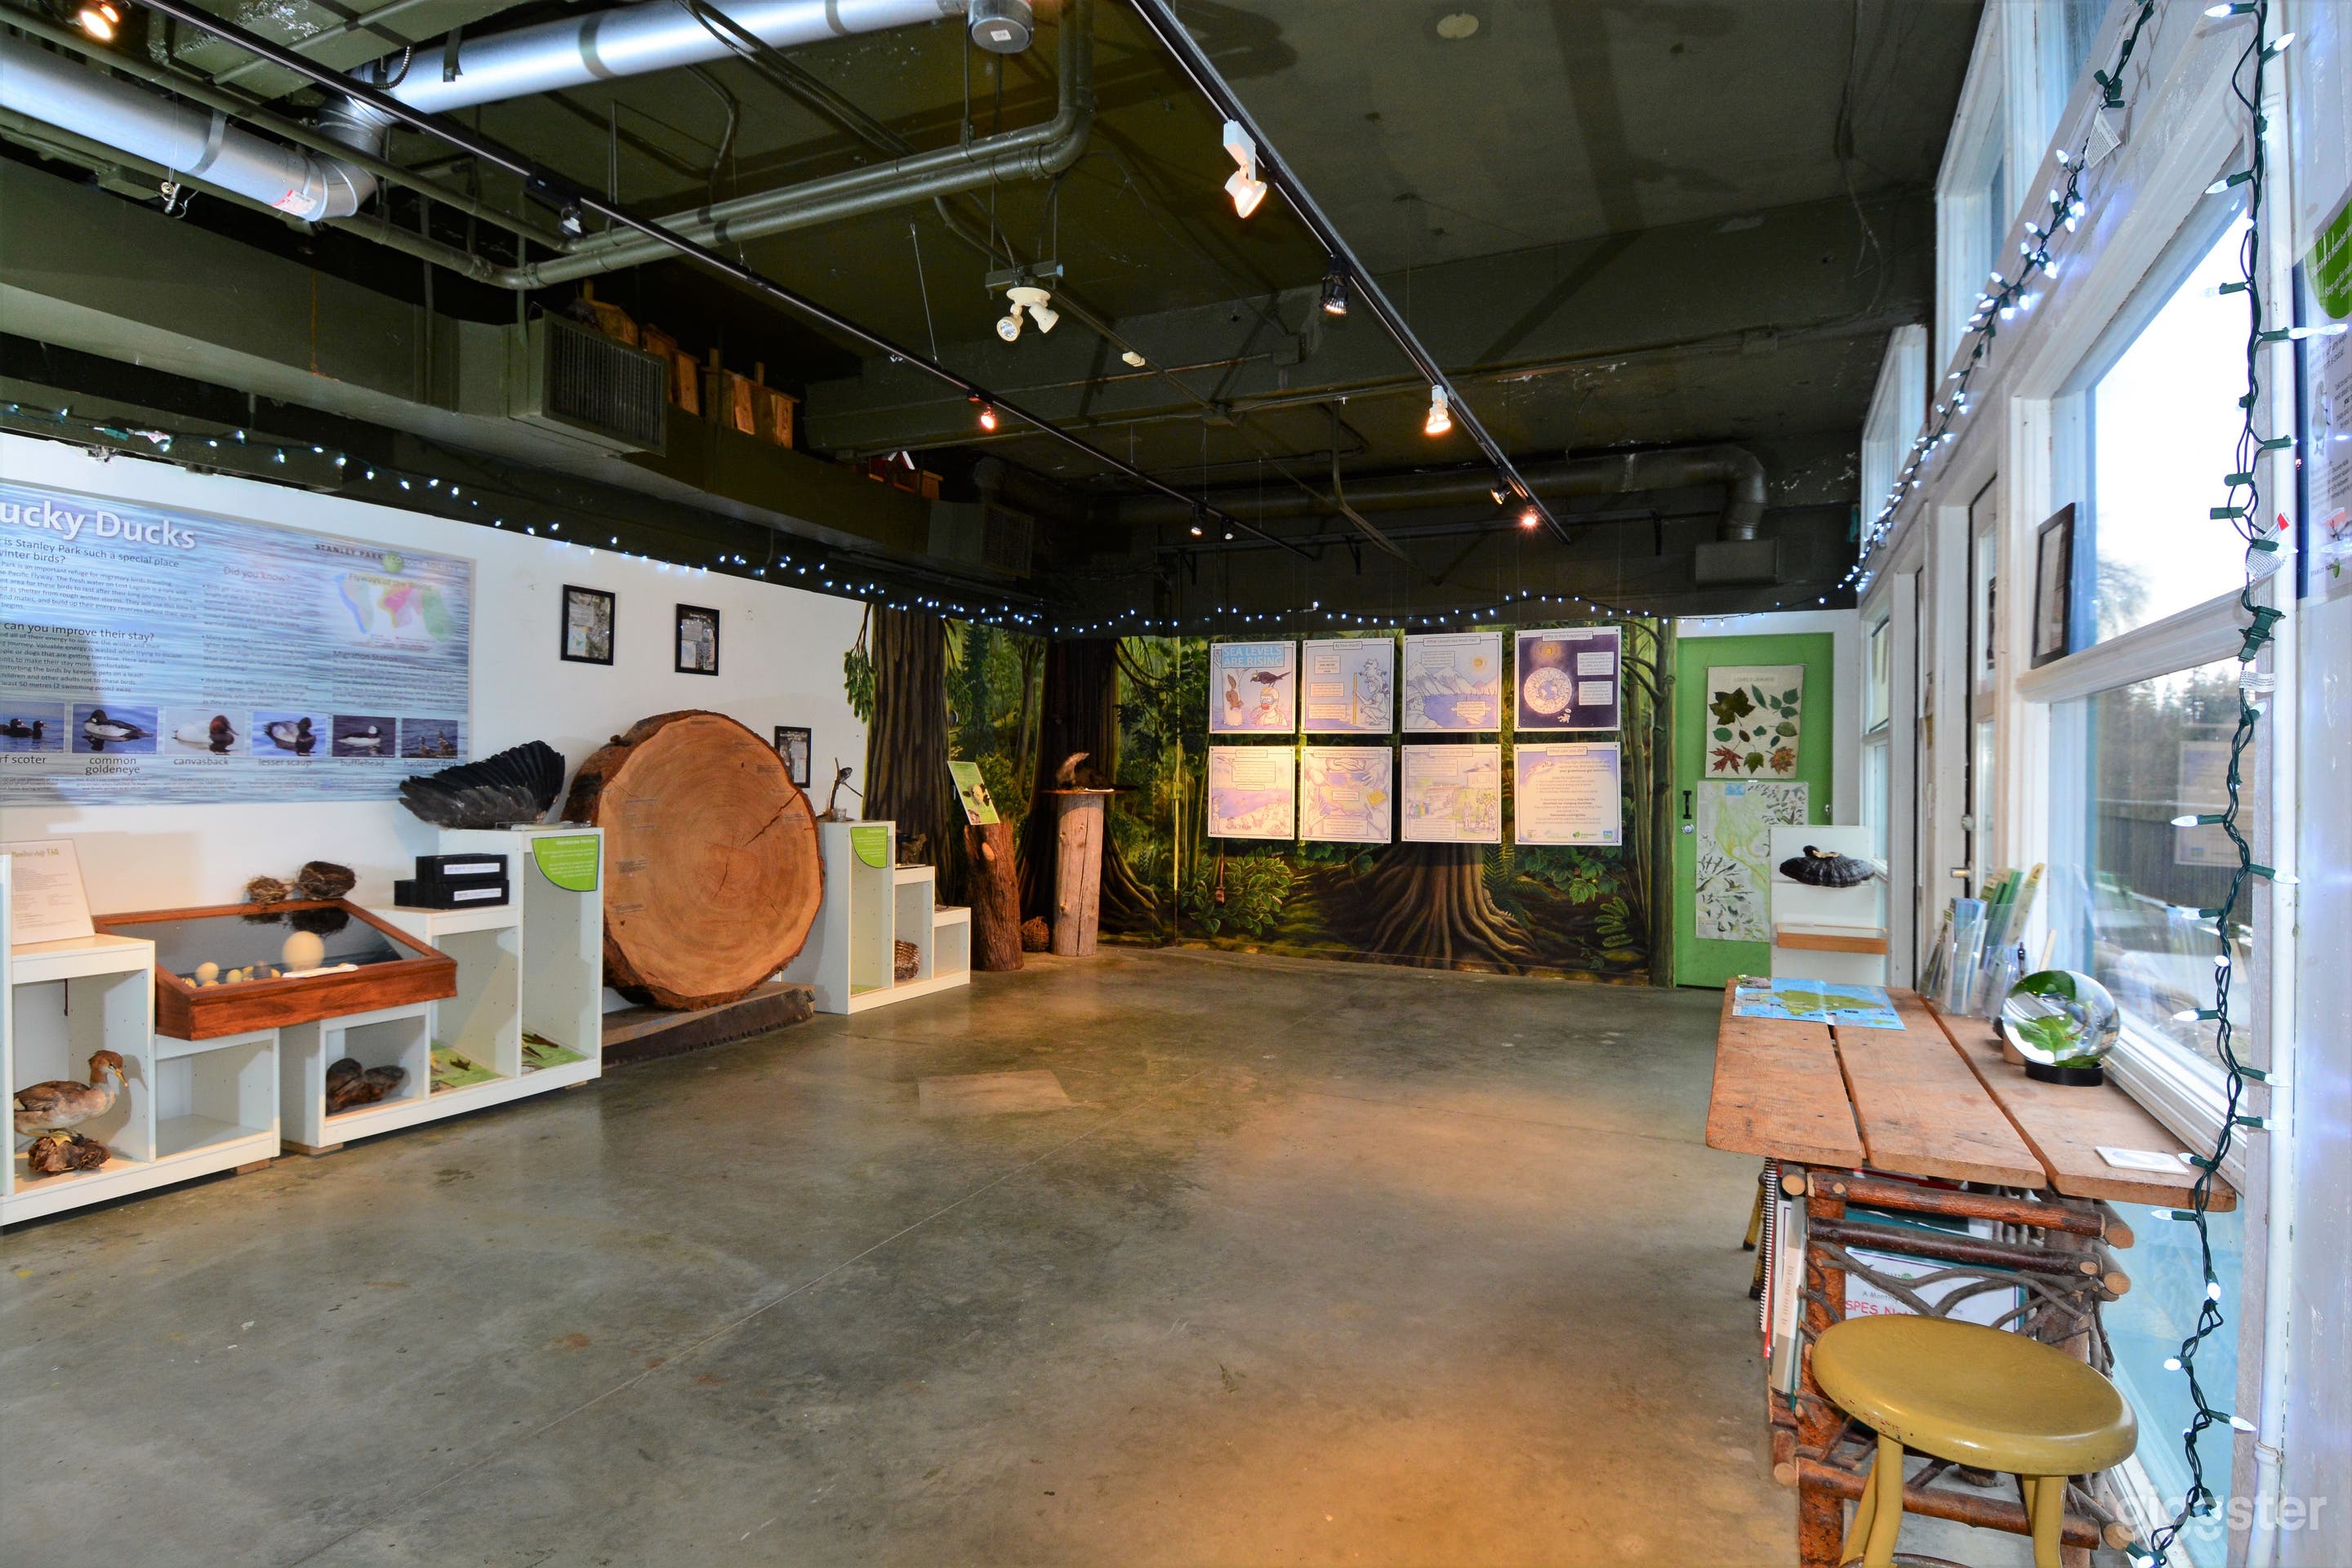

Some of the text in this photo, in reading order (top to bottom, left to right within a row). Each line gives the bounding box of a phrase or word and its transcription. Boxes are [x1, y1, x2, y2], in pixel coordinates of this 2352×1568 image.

[96, 510, 196, 549] Ducks
[5, 537, 13, 546] is
[16, 539, 55, 553] Stanley
[59, 545, 81, 555] Park
[84, 548, 107, 559] such
[118, 554, 152, 564] special
[154, 557, 180, 568] place
[314, 543, 357, 555] STANLEY
[359, 550, 382, 560] PARK
[33, 552, 65, 563] birds?
[100, 573, 129, 581] migratory
[223, 566, 240, 575] Did
[242, 571, 259, 579] you
[27, 624, 49, 634] you
[52, 625, 97, 637] improve
[100, 629, 125, 639] their
[128, 633, 154, 643] stay?
[1224, 646, 1282, 657] SEA LEVELS
[1225, 656, 1282, 666] ARE RISING
[12, 755, 47, 764] scoter
[173, 756, 229, 765] canvasback
[258, 758, 312, 768] lesser scaup
[340, 759, 385, 768] bufflehead
[85, 765, 140, 776] goldeneye
[1846, 1300, 1878, 1315] SPES
